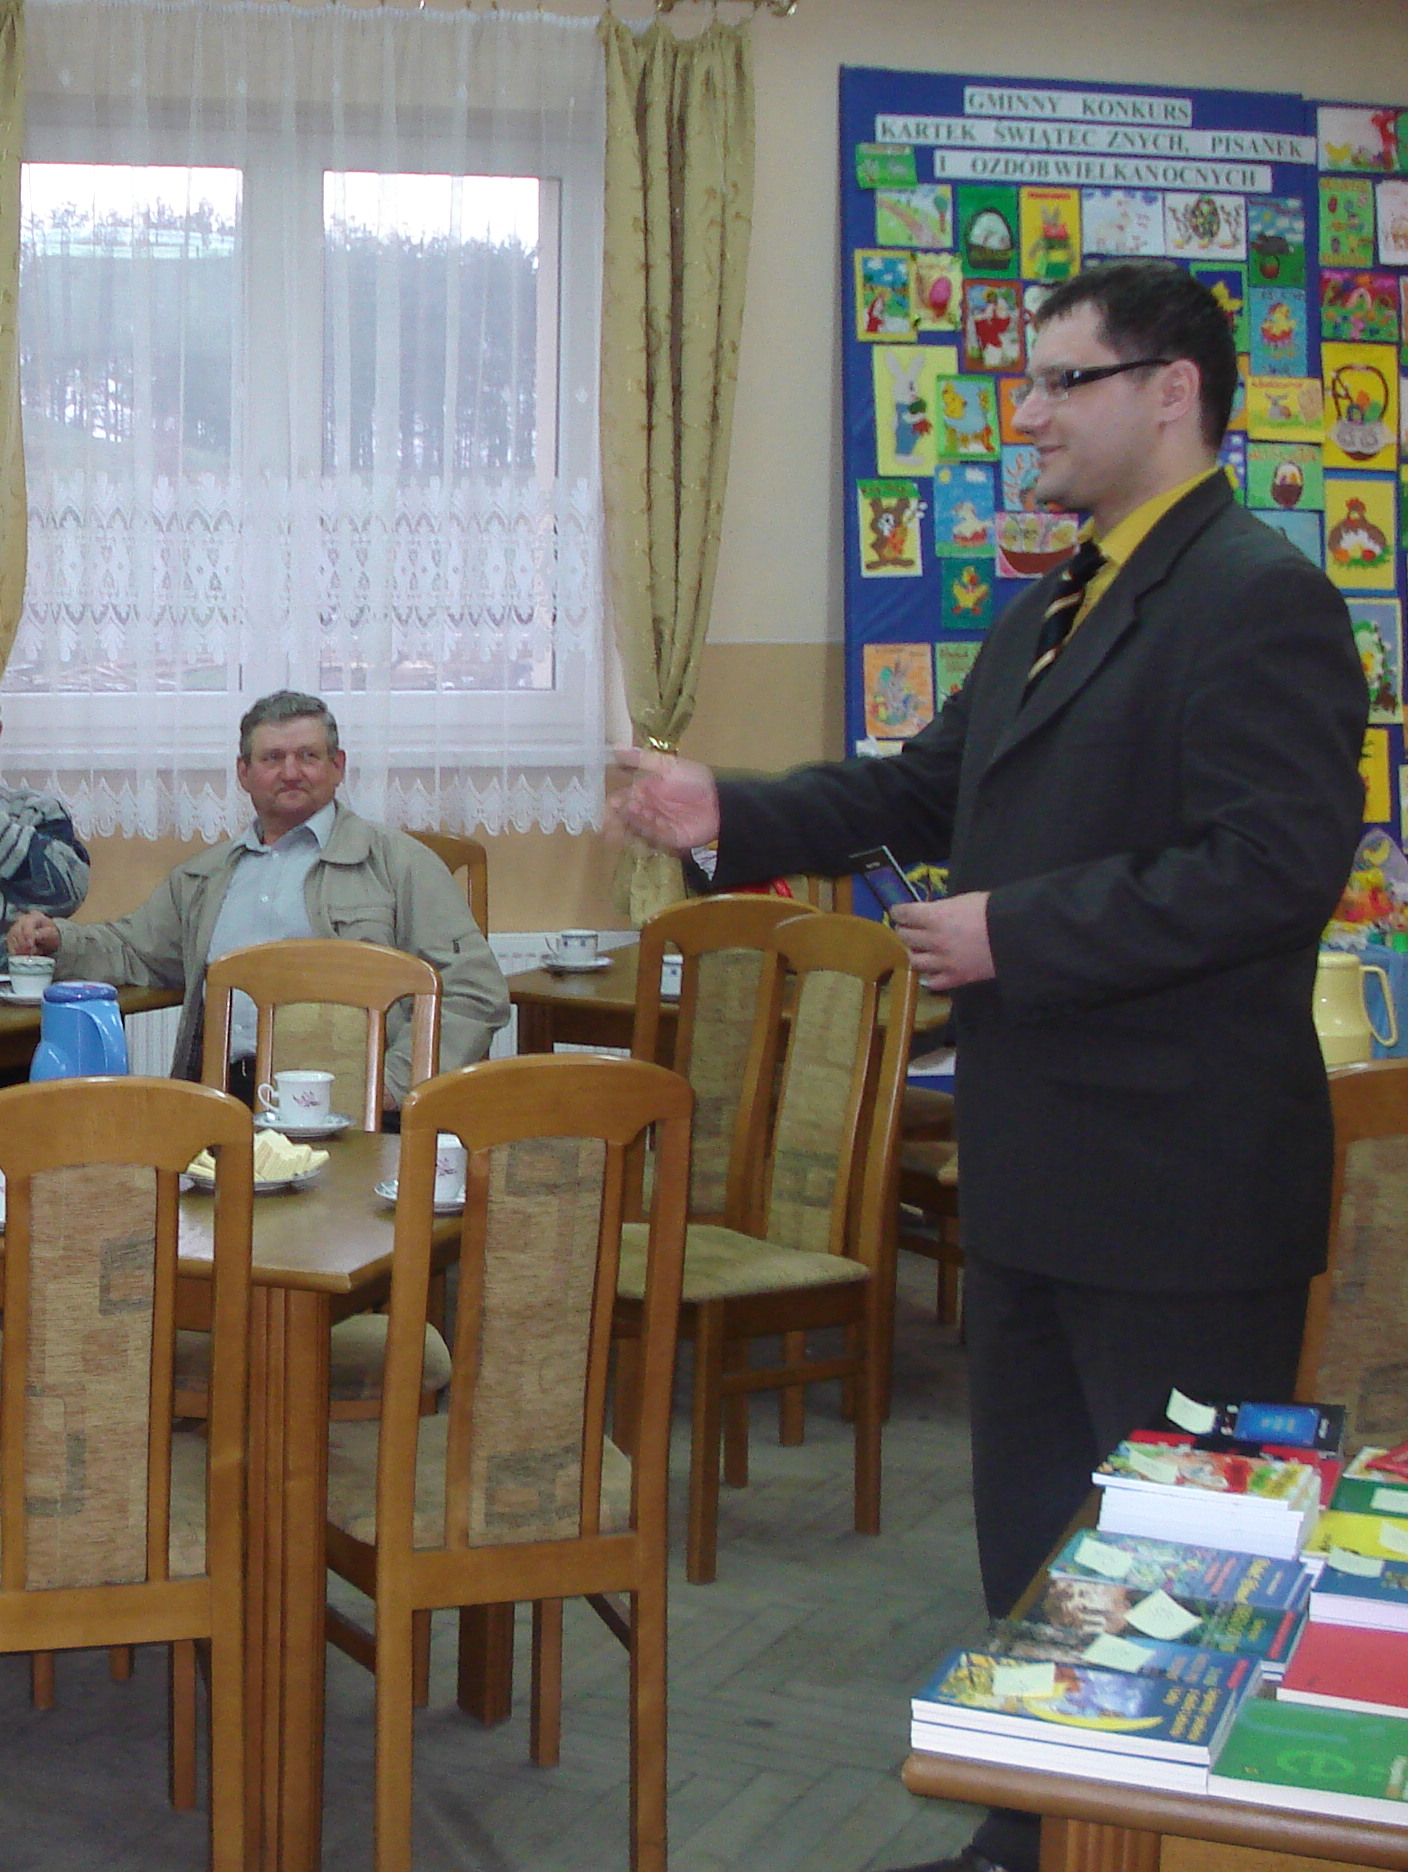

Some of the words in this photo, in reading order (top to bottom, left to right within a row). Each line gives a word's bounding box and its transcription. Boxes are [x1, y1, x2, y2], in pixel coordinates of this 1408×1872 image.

[968, 93, 1058, 114] GMINNY
[1081, 98, 1189, 121] KONKURS
[881, 121, 976, 141] KARTEK
[1211, 135, 1303, 158] PISANEK
[939, 155, 946, 173] I
